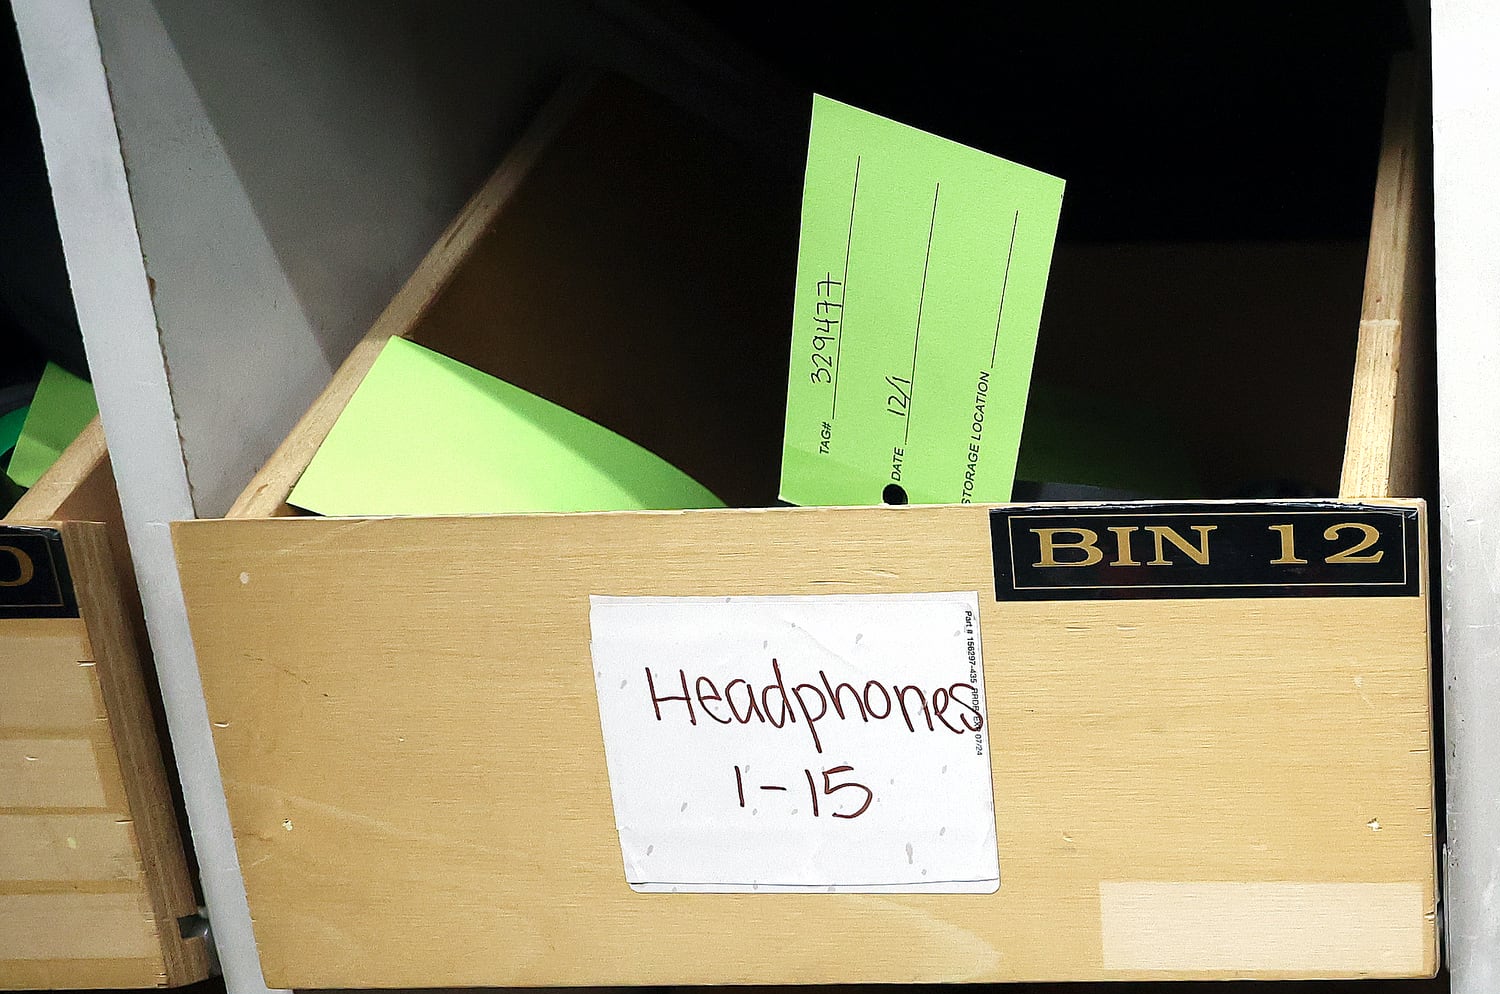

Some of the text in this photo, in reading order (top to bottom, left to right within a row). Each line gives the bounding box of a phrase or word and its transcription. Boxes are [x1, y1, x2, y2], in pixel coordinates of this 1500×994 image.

[810, 271, 842, 384] 329477
[885, 376, 912, 417] 12/1
[818, 421, 833, 455] TAG#
[961, 371, 989, 504] STORAGE LOCATION
[890, 447, 905, 482] DATE
[1029, 521, 1386, 568] BIN 12
[965, 610, 973, 627] Part
[967, 637, 978, 684] 156297-435
[643, 657, 985, 753] Headphones
[974, 734, 983, 756] 07/24
[733, 765, 874, 819] 1-15
